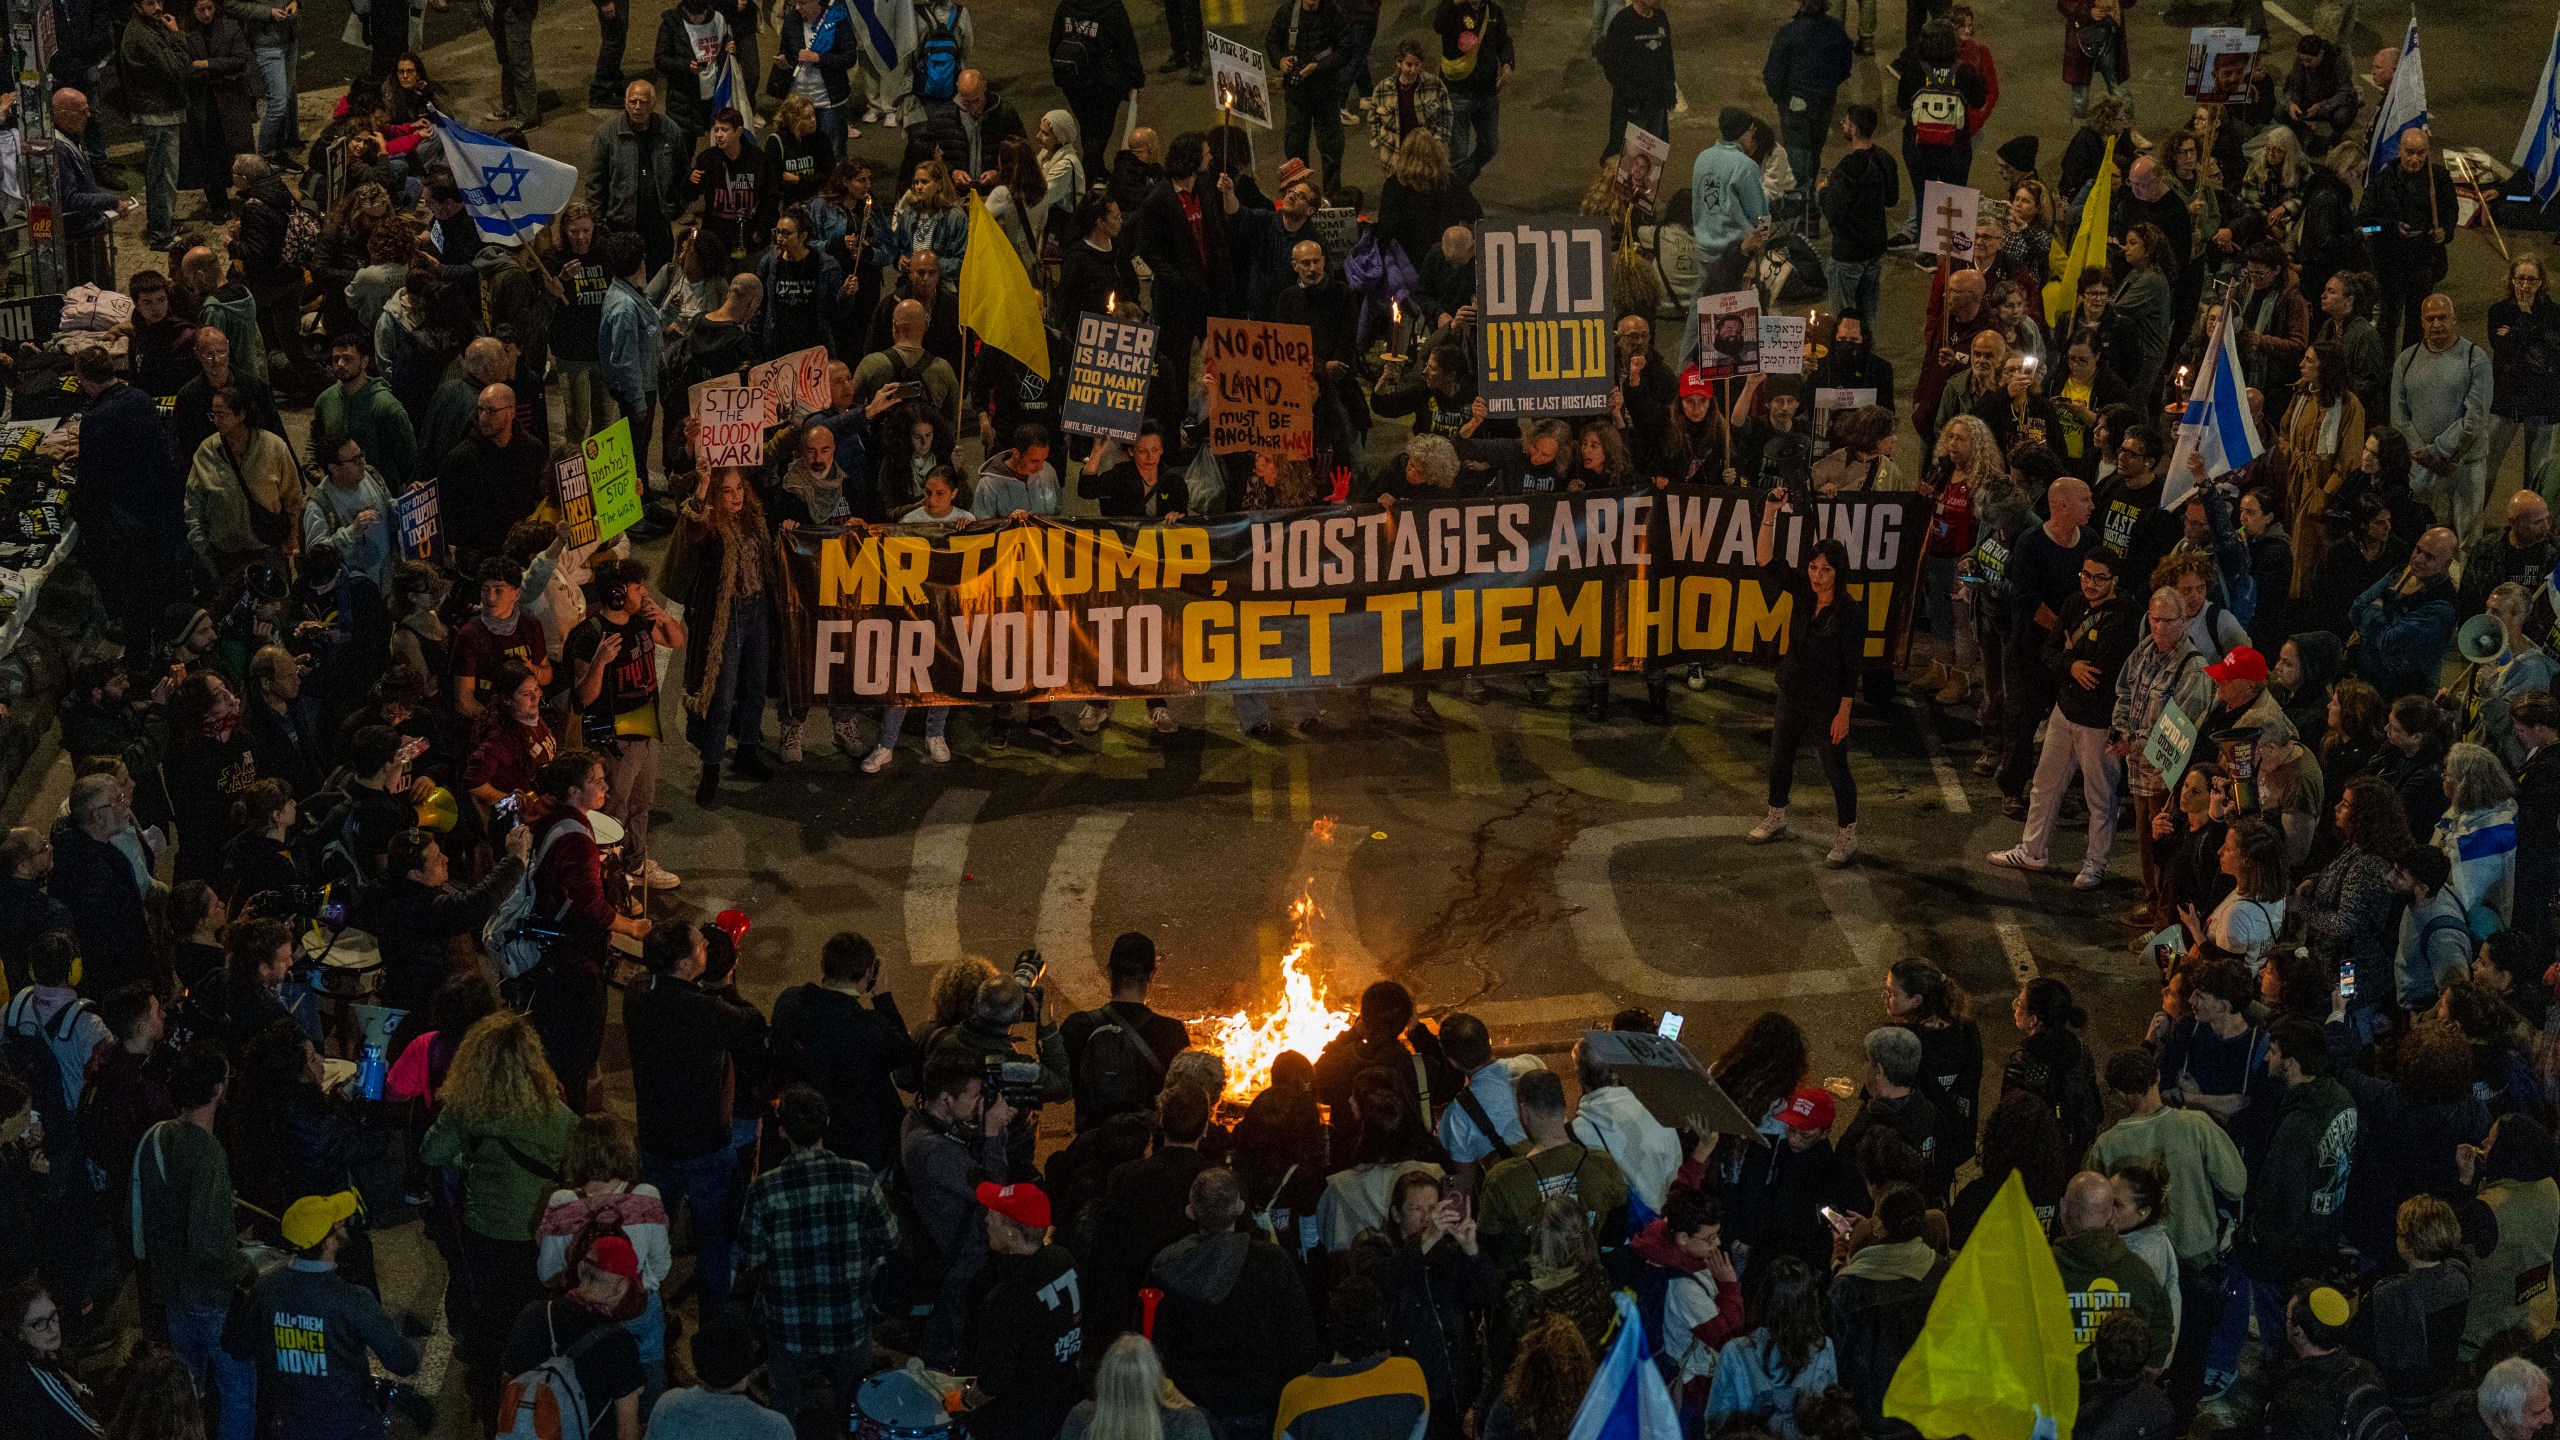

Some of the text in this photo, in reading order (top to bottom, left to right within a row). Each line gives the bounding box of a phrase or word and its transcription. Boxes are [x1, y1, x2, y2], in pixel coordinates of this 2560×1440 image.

[1485, 225, 1605, 315] כולם
[1080, 318, 1155, 356] OFER
[1213, 327, 1249, 359] NO
[1487, 319, 1606, 381] עכשיו!
[1075, 346, 1151, 375] IS BACK!
[1074, 367, 1147, 393] TOO MANY
[705, 387, 763, 412] STOP
[1068, 383, 1144, 413] NOT YET!
[1488, 394, 1607, 412] UNTIL THE LAST HOSTAGE!
[716, 409, 744, 422] THE
[1268, 411, 1292, 430] BE
[702, 421, 762, 447] BLOODY
[1063, 420, 1137, 441] UNTIL THE LAST HOSTAGE!
[706, 443, 760, 466] WAR!
[606, 477, 629, 505] STOP
[2110, 499, 2141, 519] UNTIL THE
[2105, 510, 2137, 535] LAST
[2103, 528, 2132, 547] HOSTAGE
[818, 535, 931, 608] MR
[949, 526, 1228, 598] TRUMP,
[1251, 503, 1530, 591] HOSTAGES
[1544, 496, 1653, 571] ARE
[813, 574, 1894, 695] FOR YOU TO GET THEM HOM!
[2178, 734, 2190, 755] לא
[274, 1311, 292, 1327] ALL
[297, 1315, 324, 1331] THEM
[274, 1326, 325, 1353] HOME!
[276, 1347, 328, 1376] NOW!
